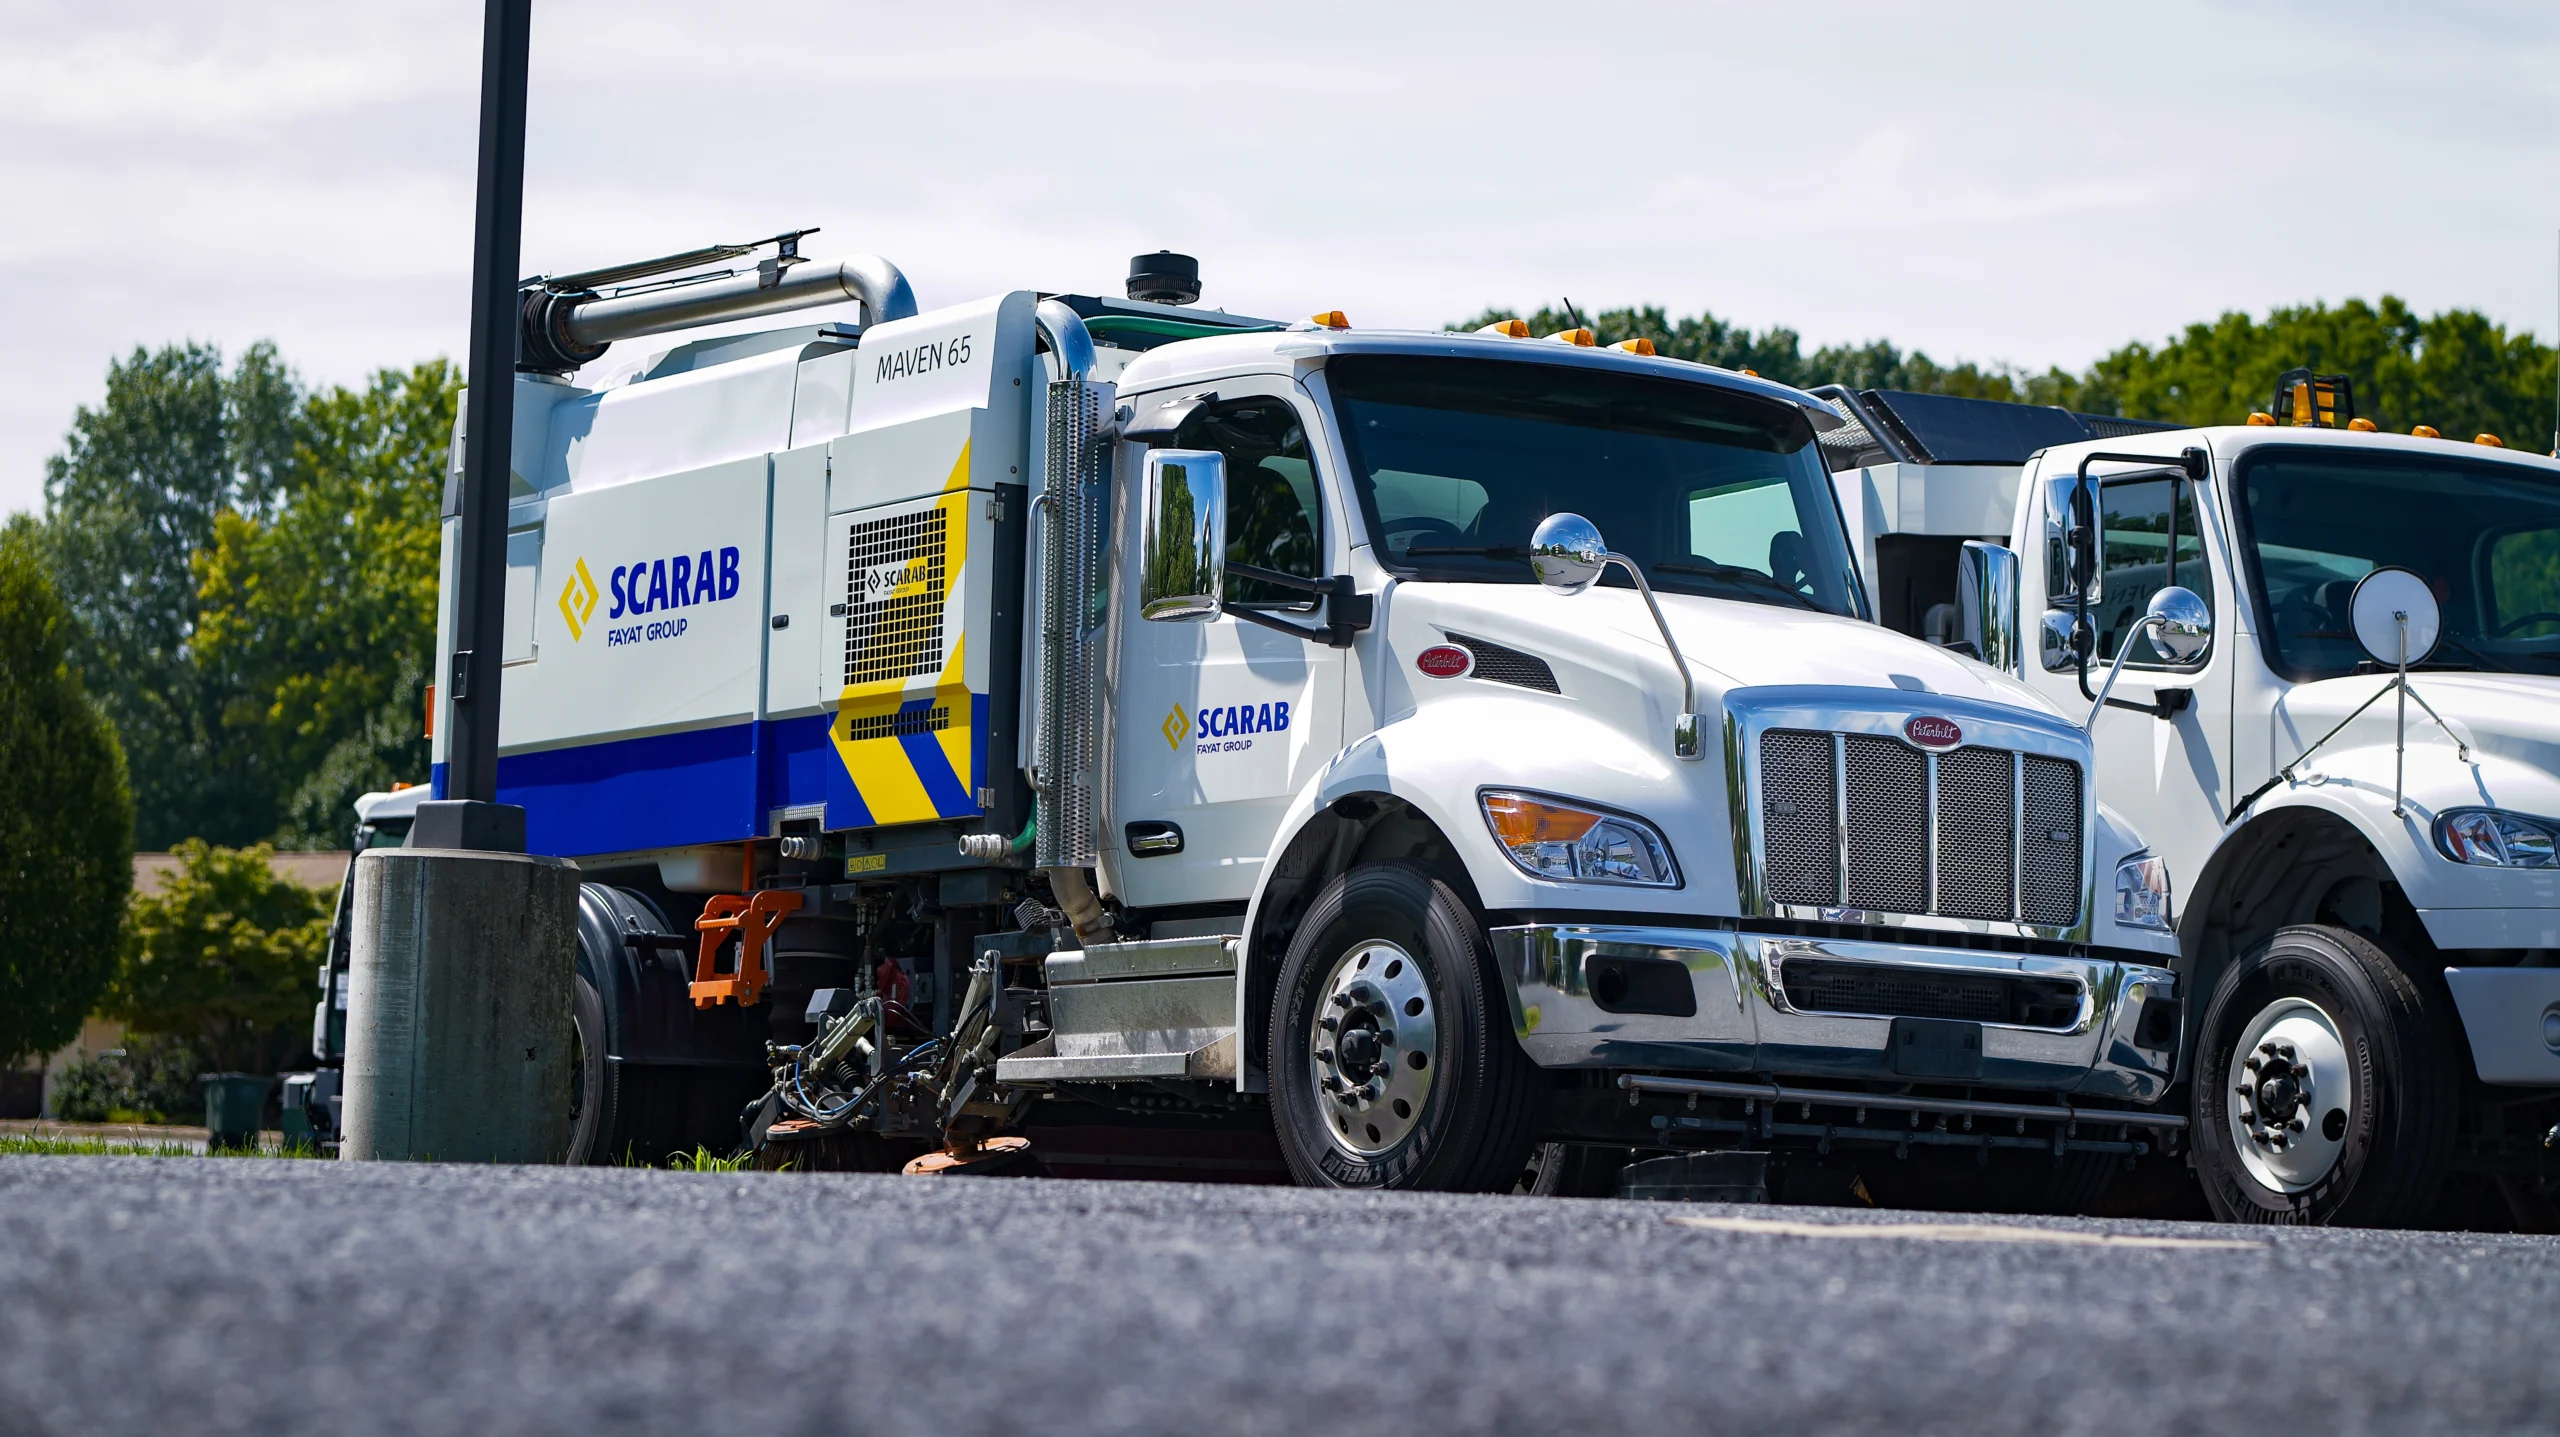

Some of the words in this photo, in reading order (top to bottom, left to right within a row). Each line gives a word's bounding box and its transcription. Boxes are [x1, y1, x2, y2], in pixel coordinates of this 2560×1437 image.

[876, 341, 943, 384] MAVEN
[947, 334, 971, 366] 65
[609, 546, 740, 619] SCARAB
[884, 565, 926, 587] SCARAB
[608, 625, 643, 647] FAYAT
[646, 618, 688, 641] GROUP
[1422, 652, 1464, 669] Peterbilt
[1197, 701, 1290, 739] SCARAB
[1912, 720, 1957, 739] Peterbilt
[1196, 742, 1221, 755] FAYAT
[1223, 739, 1252, 753] GROUP
